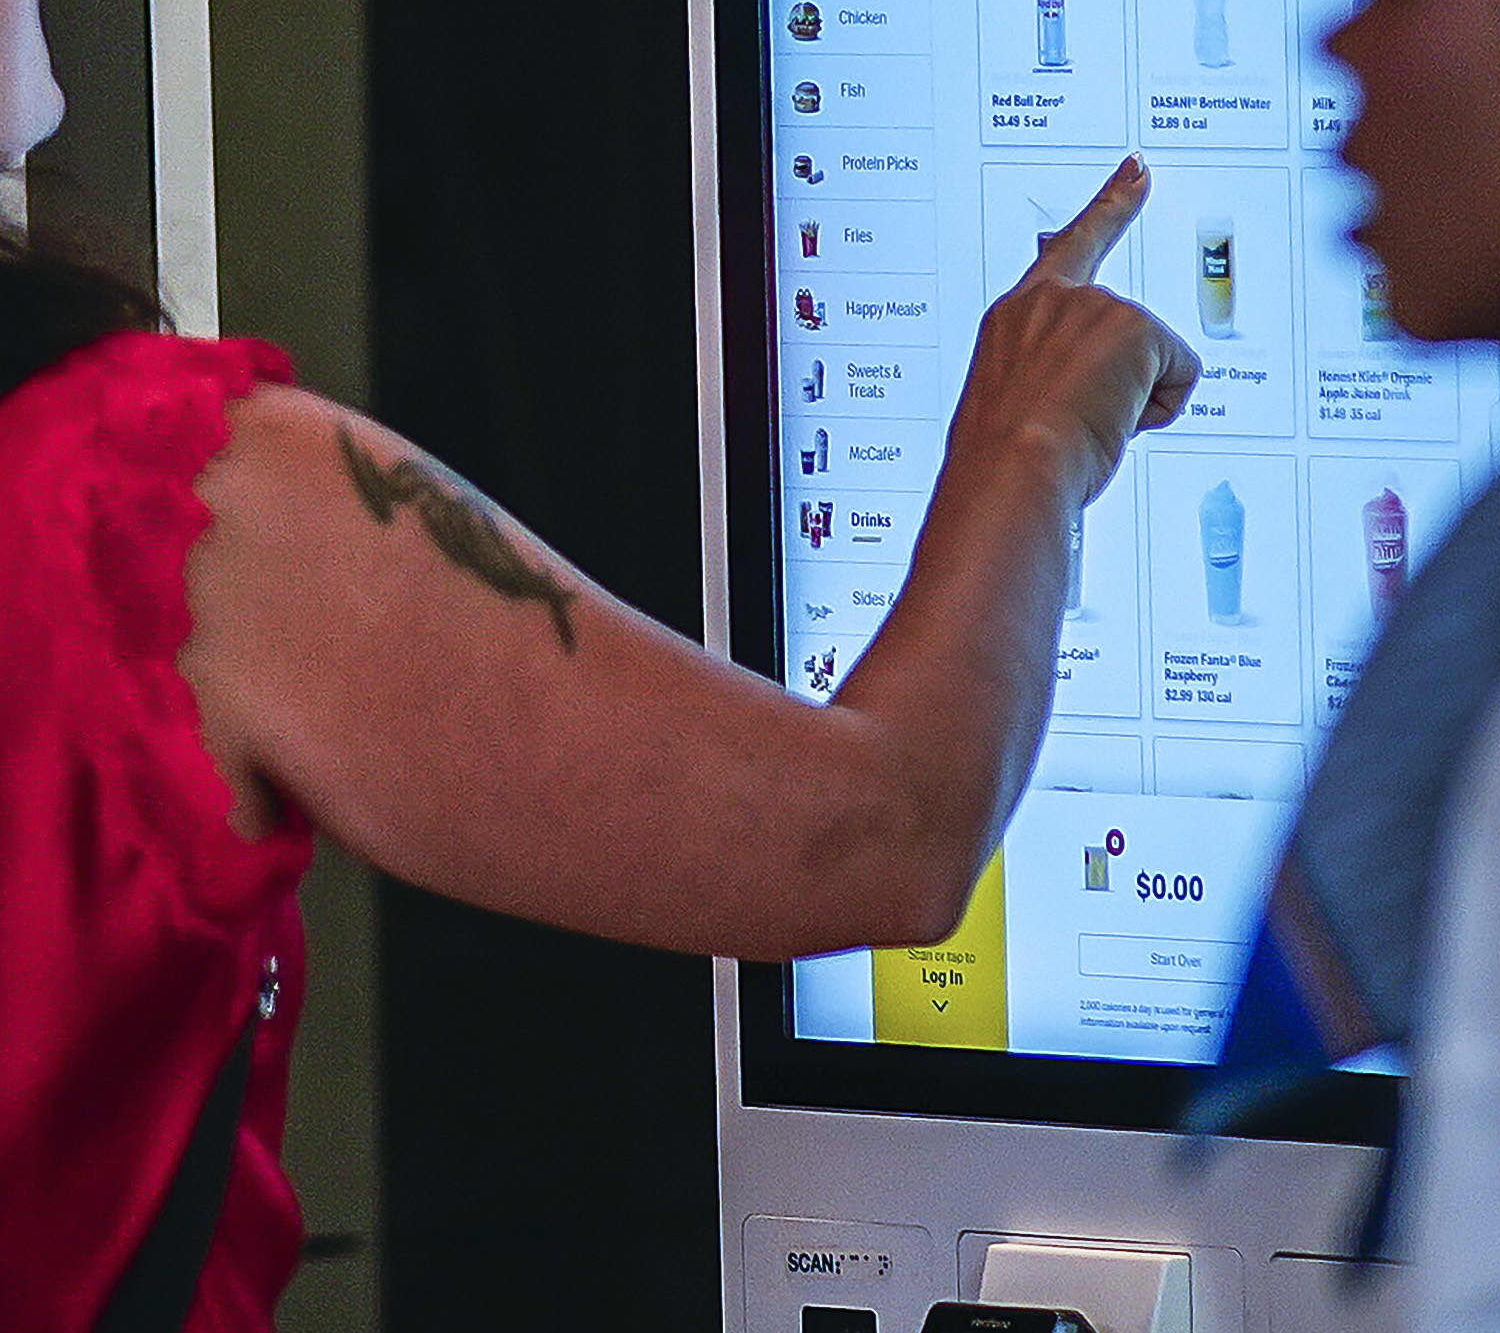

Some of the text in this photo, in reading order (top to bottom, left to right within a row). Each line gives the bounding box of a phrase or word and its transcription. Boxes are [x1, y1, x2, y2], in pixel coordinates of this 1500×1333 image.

[839, 10, 887, 25] Chicken
[841, 83, 866, 98] Fish
[992, 94, 1033, 107] Red Bull
[1199, 96, 1238, 110] Bottled
[1239, 96, 1271, 110] Water
[992, 115, 1047, 129] $3.49 5 cal
[1191, 117, 1207, 129] cal
[842, 155, 919, 171] Protein Picks
[844, 228, 874, 243] Fries
[846, 301, 883, 320] Happy
[847, 362, 902, 379] Sweets &
[1229, 368, 1267, 384] Orange
[849, 383, 885, 399] Treats
[1210, 405, 1225, 417] cal
[1365, 408, 1381, 421] cal
[851, 512, 891, 528] Drinks
[852, 590, 885, 607] Sides
[1165, 652, 1261, 668] Frozen Blue
[1165, 669, 1218, 686] Raspberry
[1216, 691, 1232, 704] cal
[1136, 868, 1204, 903] $0.00
[1151, 953, 1202, 968] Start Over
[922, 968, 963, 988] Log In
[787, 1253, 834, 1274] SCAN
